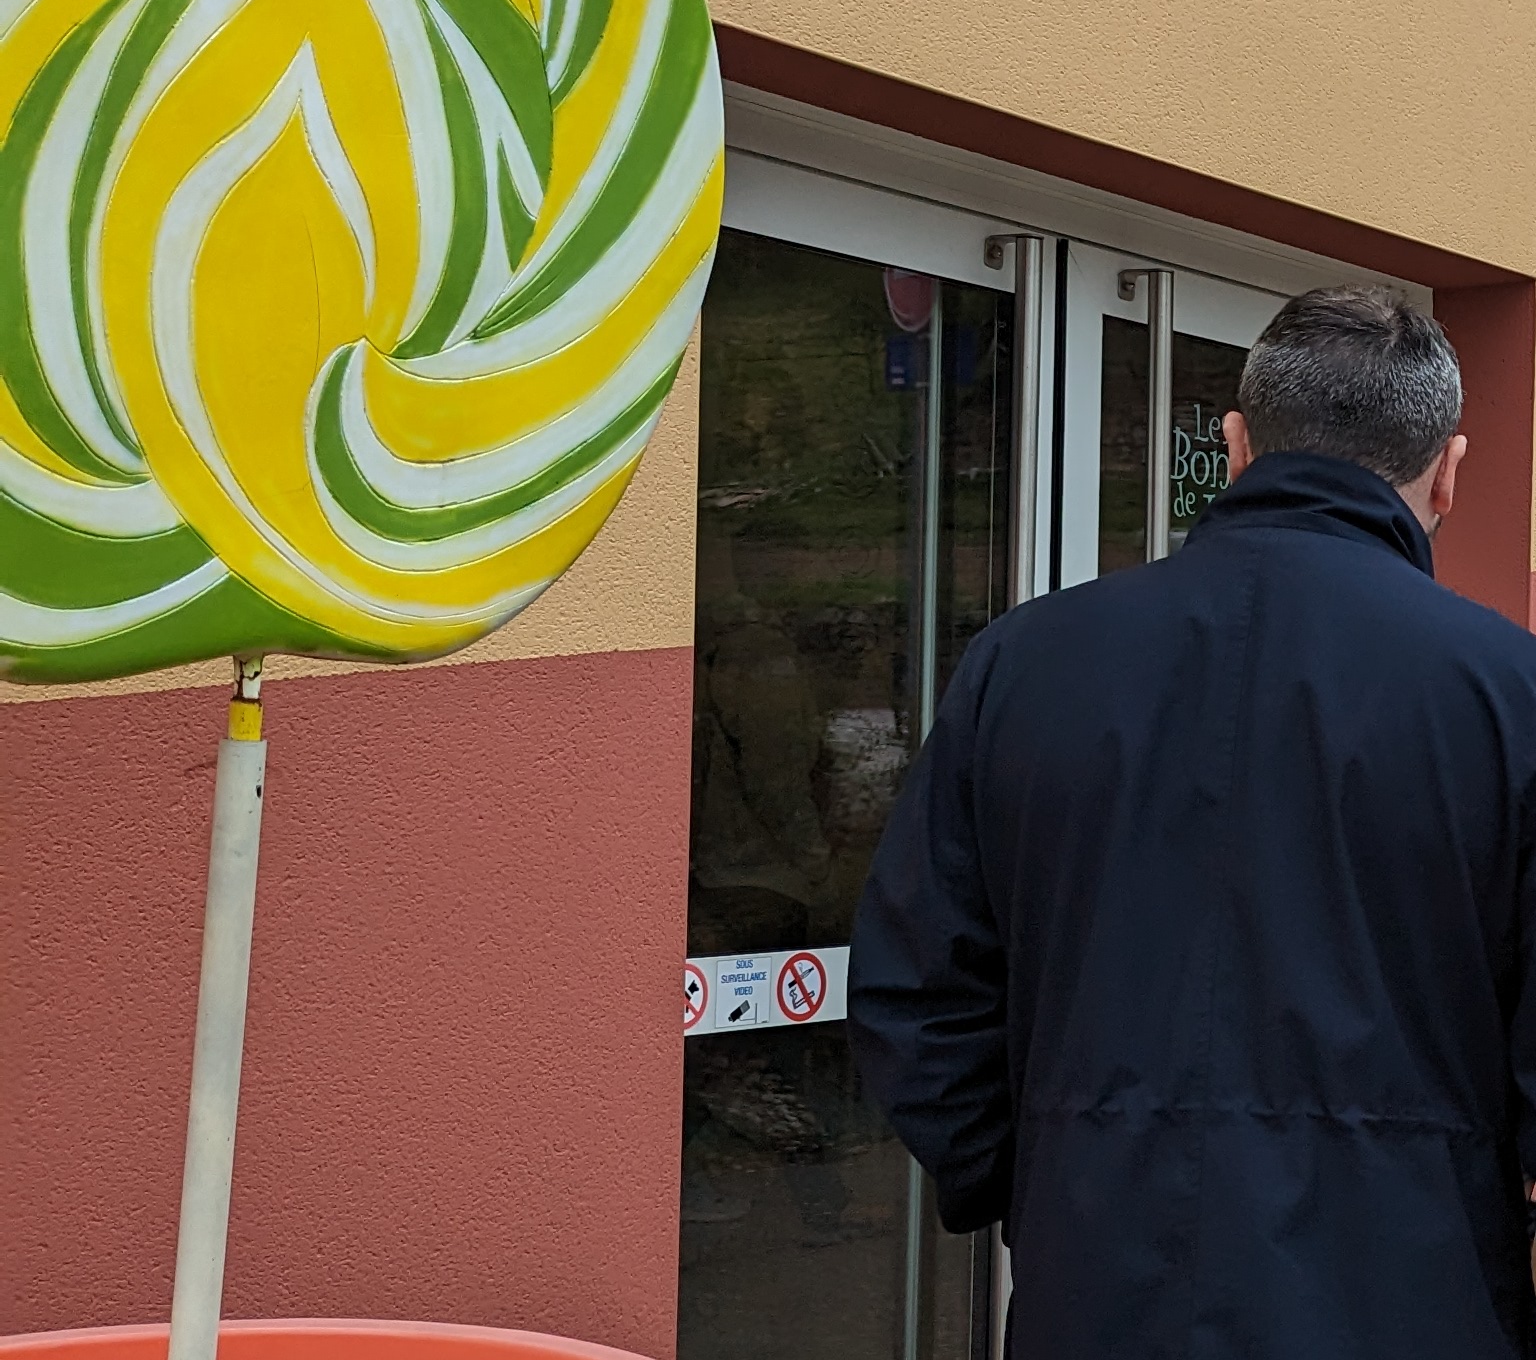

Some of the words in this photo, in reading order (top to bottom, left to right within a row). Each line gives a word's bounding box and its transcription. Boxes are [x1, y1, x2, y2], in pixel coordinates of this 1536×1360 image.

[1193, 403, 1228, 445] Le
[1173, 481, 1196, 517] de
[736, 960, 754, 969] SOUS
[721, 972, 767, 983] SURVEILLANCE
[734, 986, 753, 996] VIDEO
